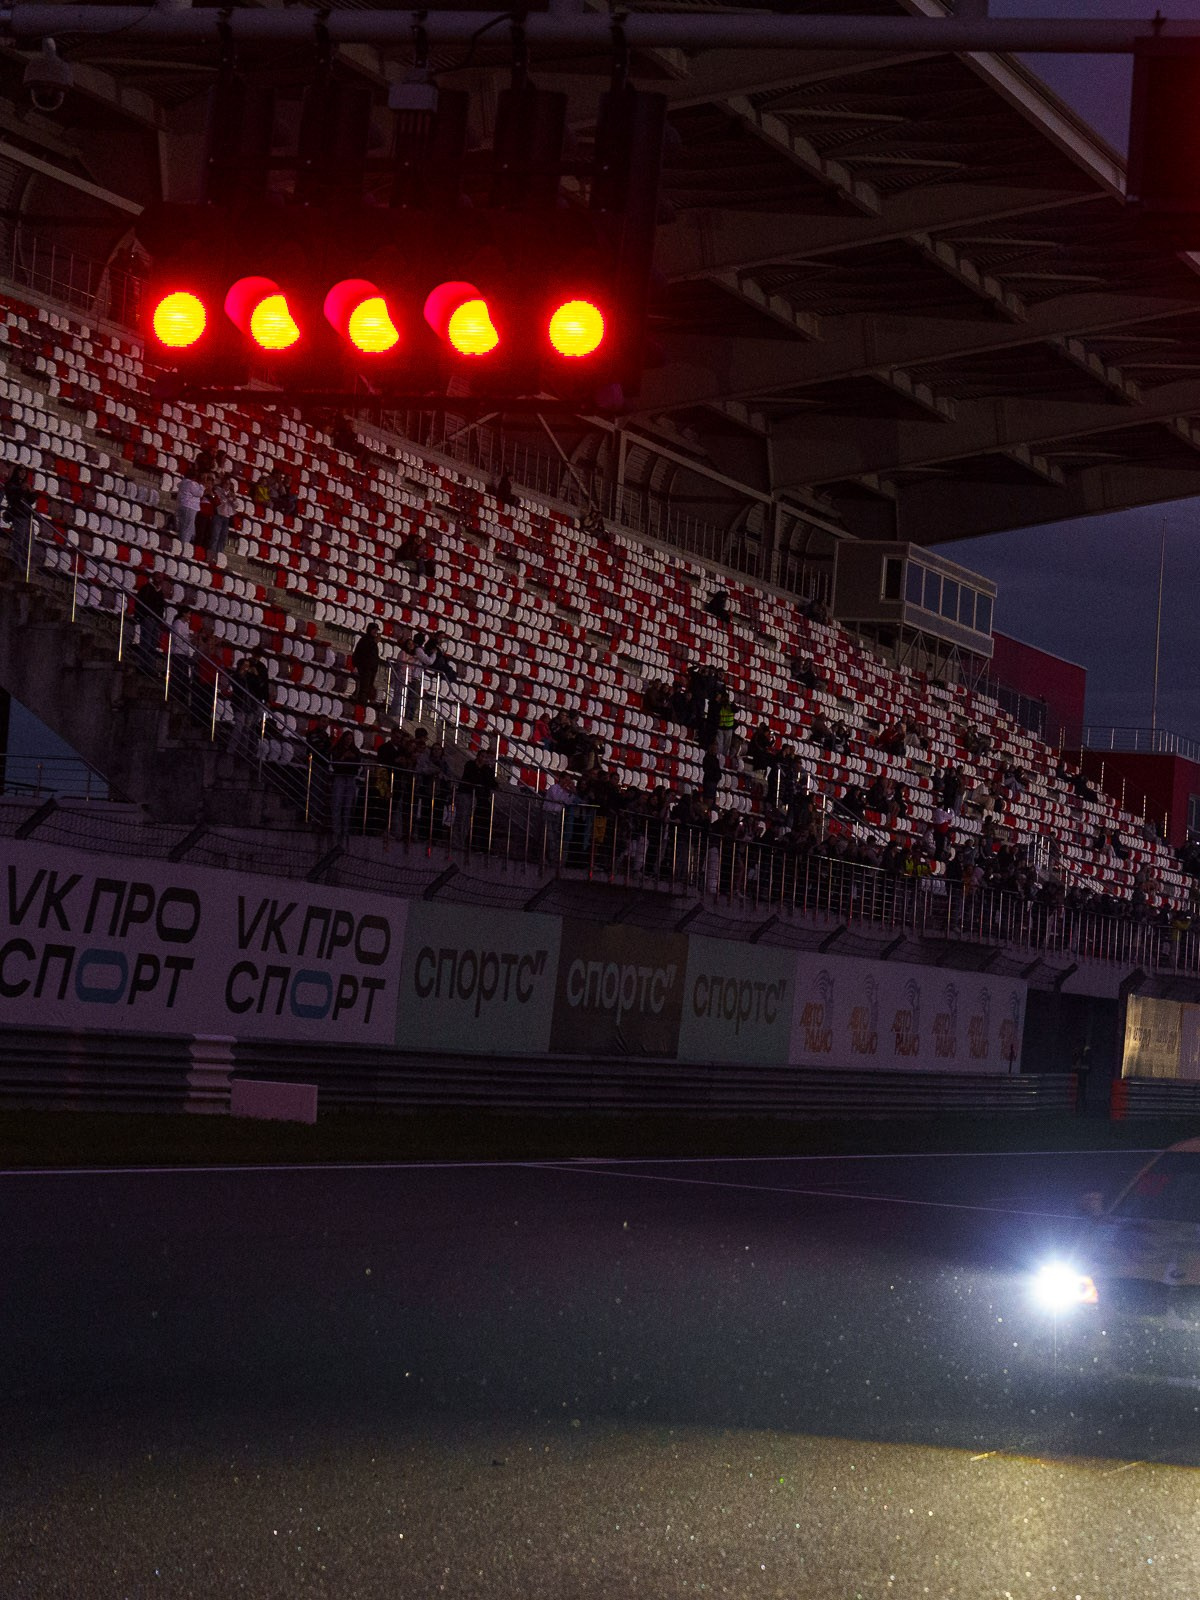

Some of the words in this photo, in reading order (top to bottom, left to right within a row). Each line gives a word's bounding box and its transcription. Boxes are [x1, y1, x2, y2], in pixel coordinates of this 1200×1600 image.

[8, 865, 83, 933] VK
[84, 877, 201, 943] ПРО
[237, 896, 298, 954] VK
[298, 905, 392, 966] ПРО
[0, 938, 195, 1008] СПОРТ
[225, 960, 386, 1024] СПОРТ
